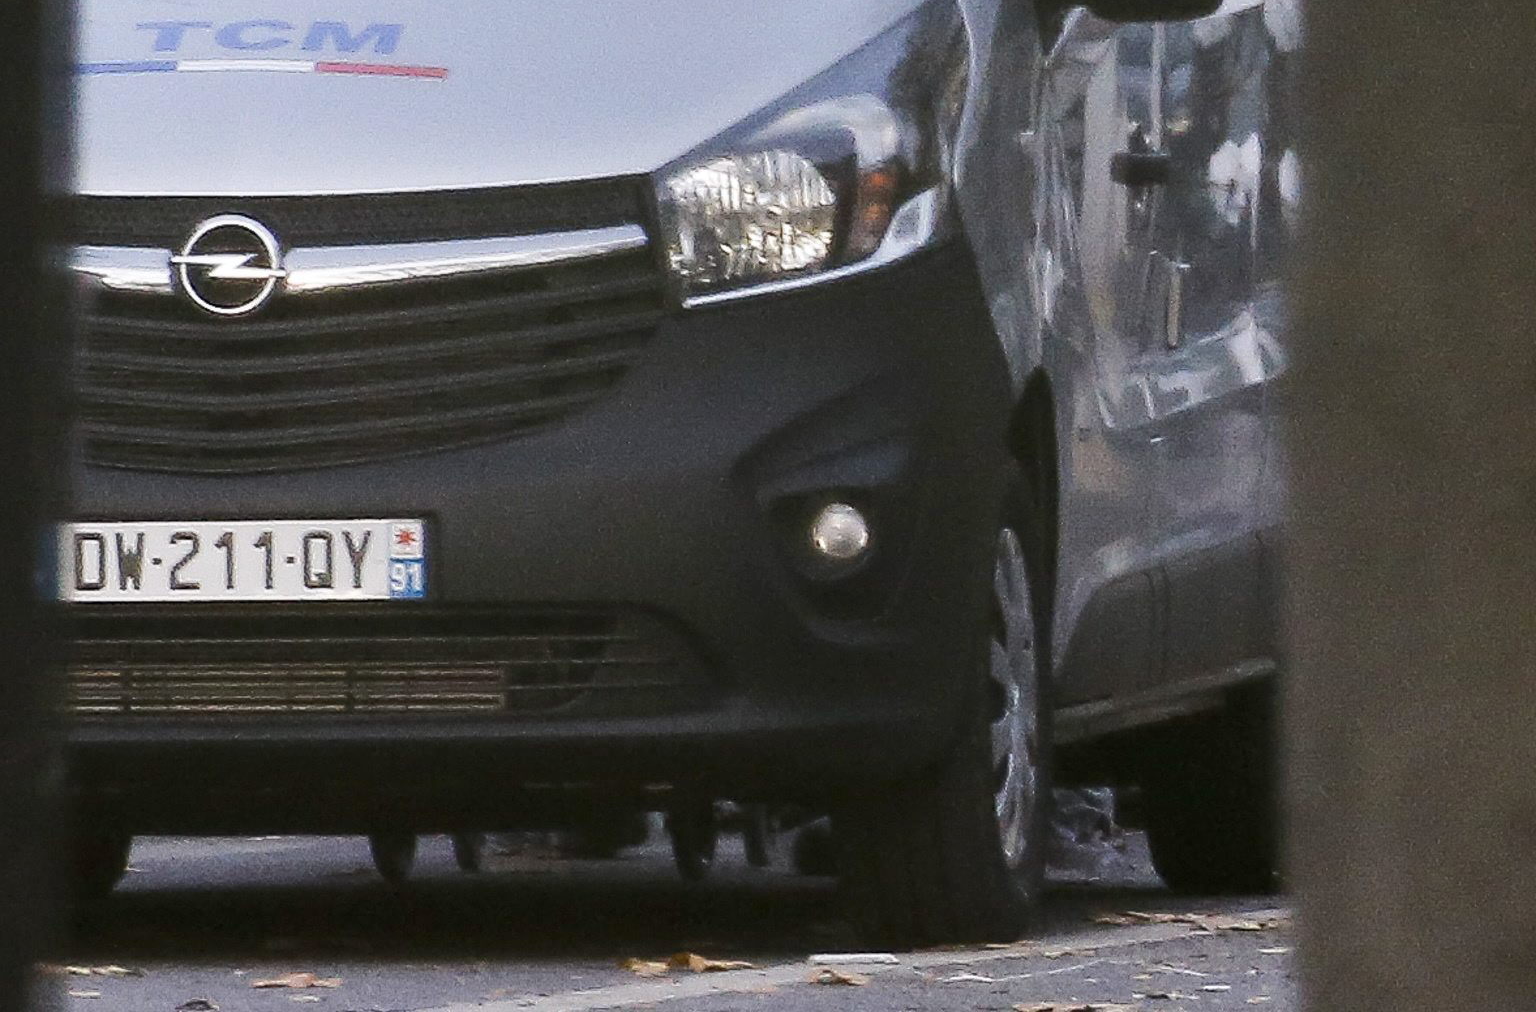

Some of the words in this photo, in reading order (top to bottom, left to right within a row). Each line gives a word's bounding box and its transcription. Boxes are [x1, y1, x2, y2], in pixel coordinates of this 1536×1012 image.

[135, 19, 406, 56] TCM
[74, 529, 373, 592] DW-211-QY
[390, 560, 424, 592] 91
